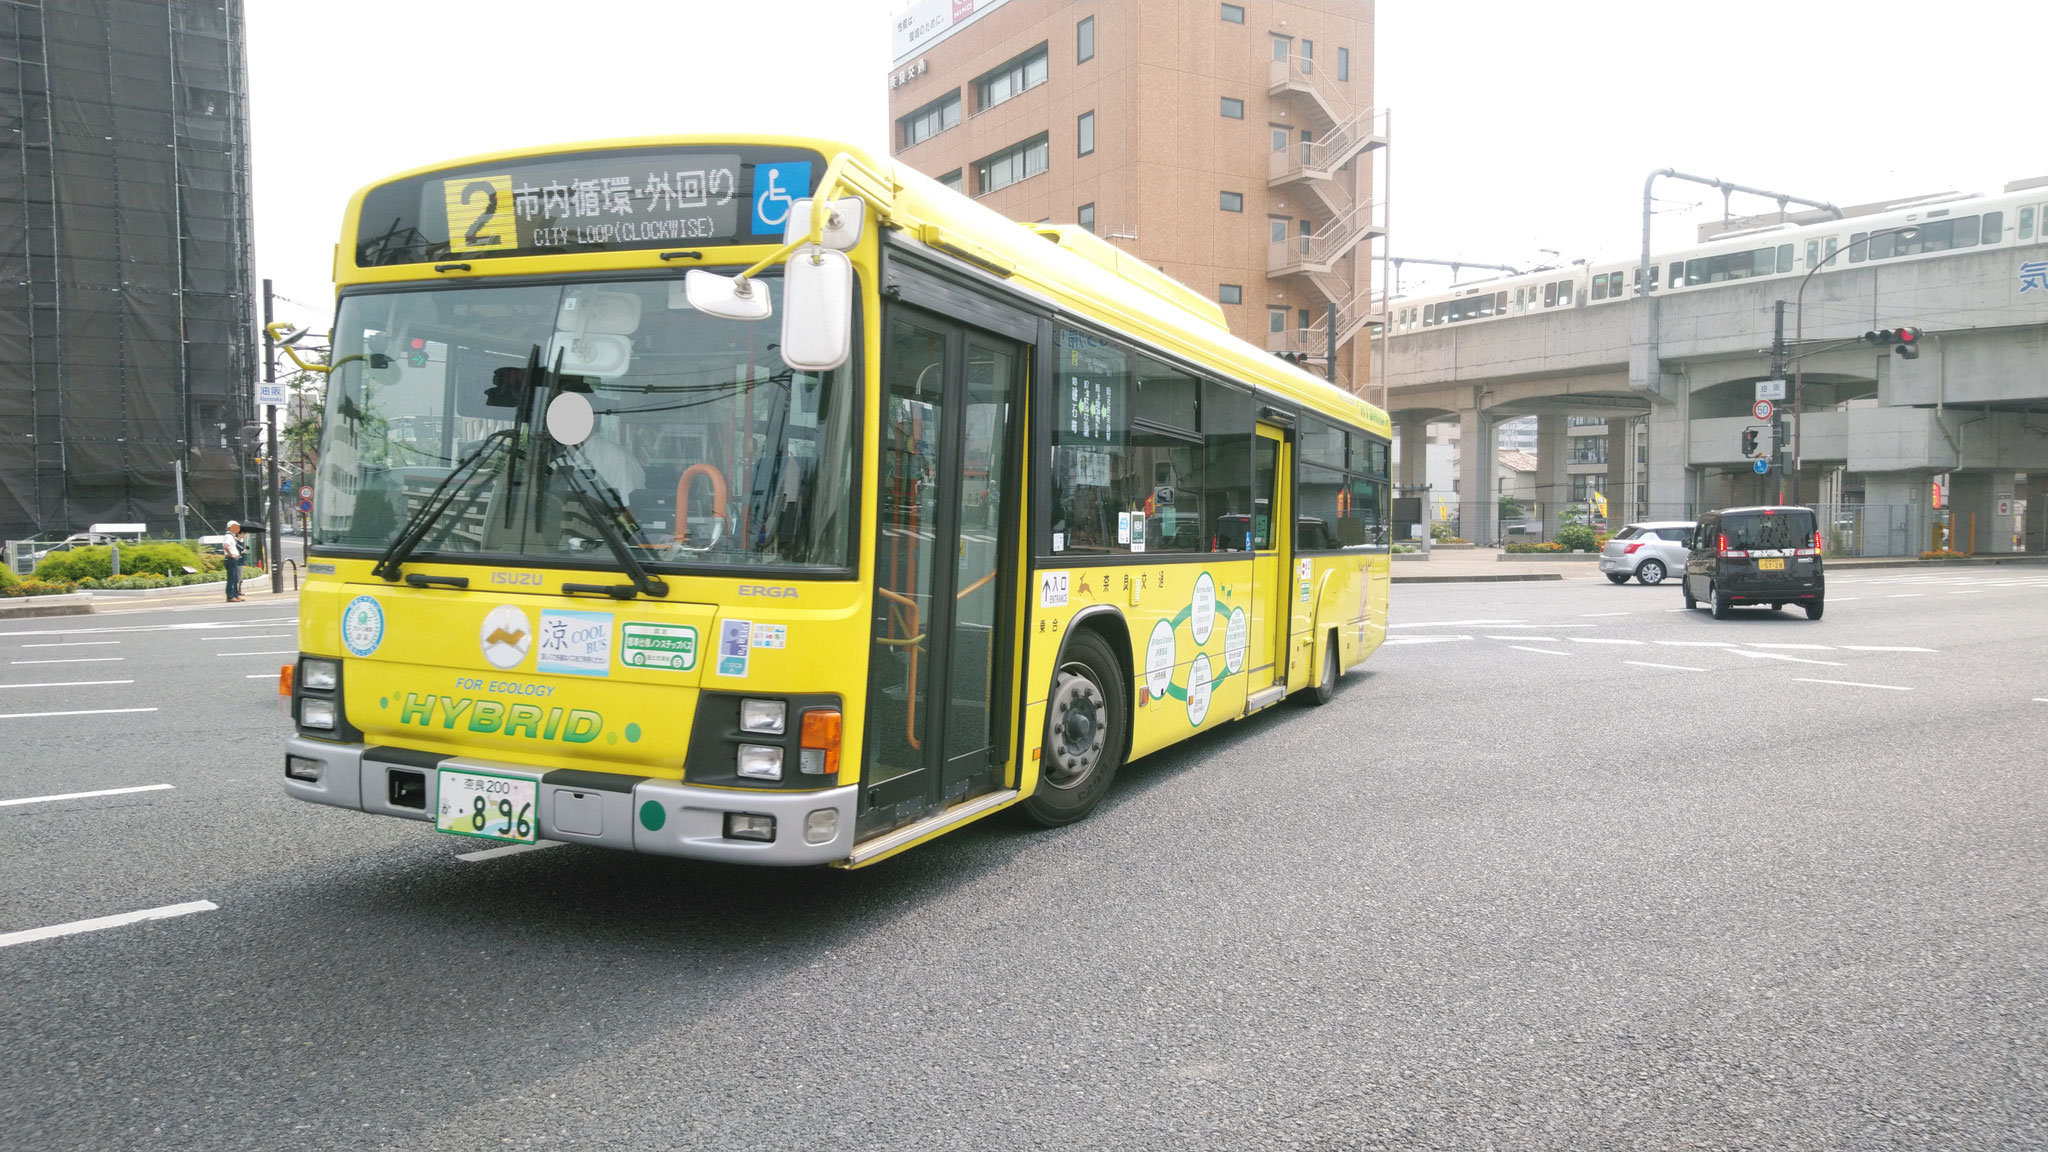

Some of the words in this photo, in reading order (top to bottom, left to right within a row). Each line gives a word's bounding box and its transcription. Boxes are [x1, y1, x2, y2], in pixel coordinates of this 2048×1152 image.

[954, 3, 973, 18] HINO
[889, 58, 928, 90] 奈良交通
[461, 180, 502, 247] 2
[533, 227, 569, 247] CITY
[577, 216, 715, 244] LOOP(CLOCKWISE)
[260, 386, 281, 396] 油阪
[1757, 405, 1769, 415] 50
[491, 572, 543, 586] ISUZU
[1052, 576, 1067, 592] 入口
[738, 585, 799, 599] ERGA
[1049, 594, 1068, 604] ENTRANCE
[543, 620, 569, 651] 涼
[571, 625, 606, 644] COOL
[586, 638, 608, 654] BUS
[627, 637, 692, 650] 標準仕様ノンステップバス
[455, 678, 483, 691] FOR
[488, 681, 556, 697] ECOLOGY
[400, 692, 604, 744] HYBRID
